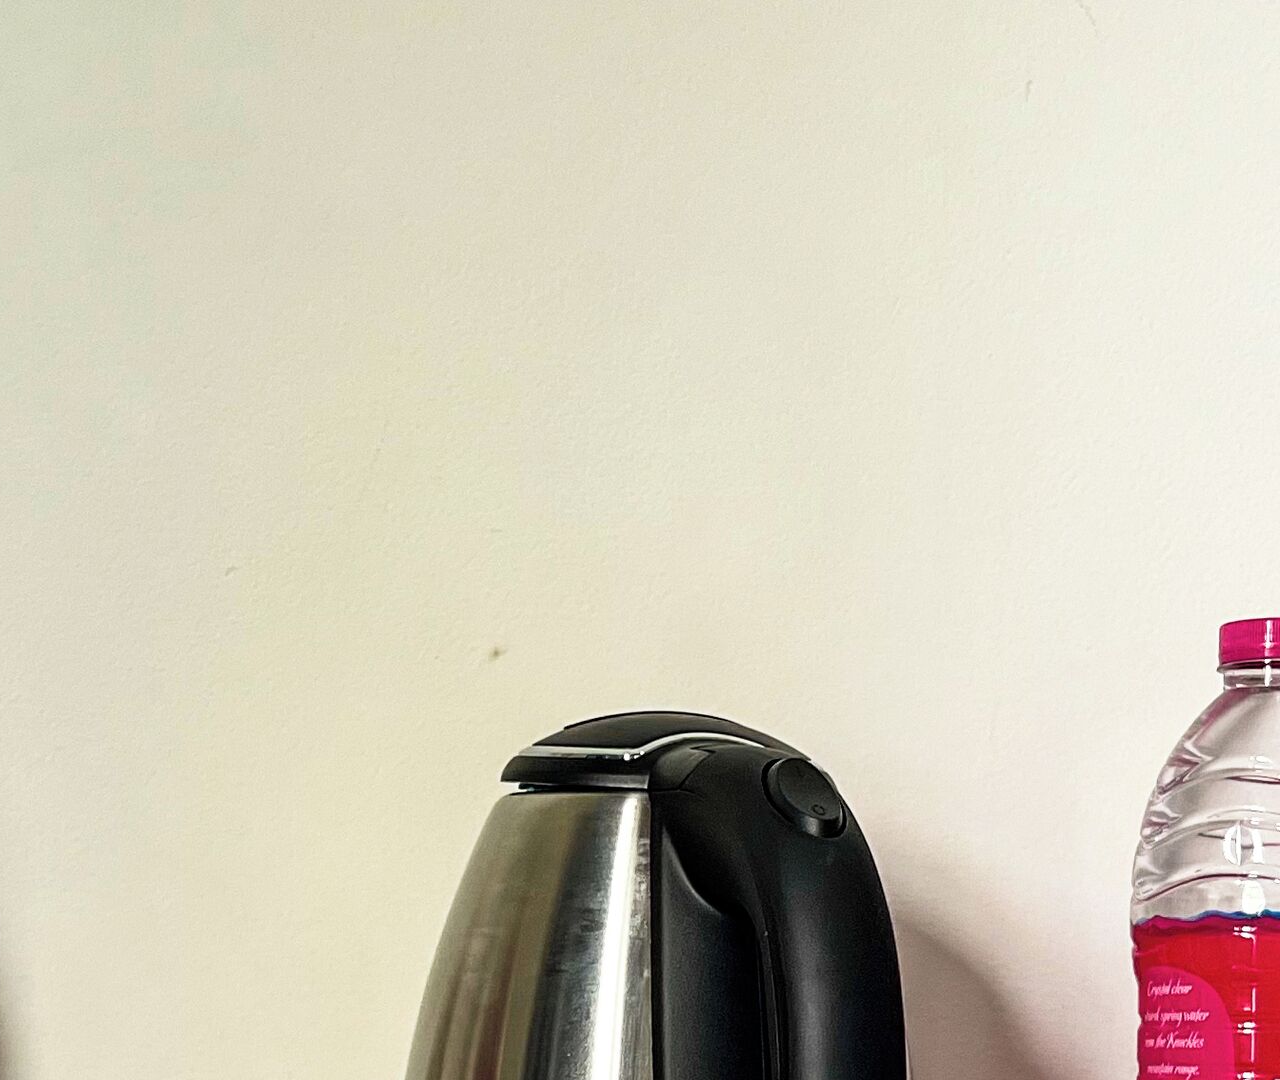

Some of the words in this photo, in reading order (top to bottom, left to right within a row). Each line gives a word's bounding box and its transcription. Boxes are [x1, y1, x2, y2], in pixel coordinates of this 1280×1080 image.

[1147, 979, 1172, 1000] Crystal
[1171, 978, 1192, 995] clear
[1160, 1010, 1182, 1028] spring
[1184, 1007, 1210, 1022] water
[1166, 1031, 1204, 1049] Knuckles
